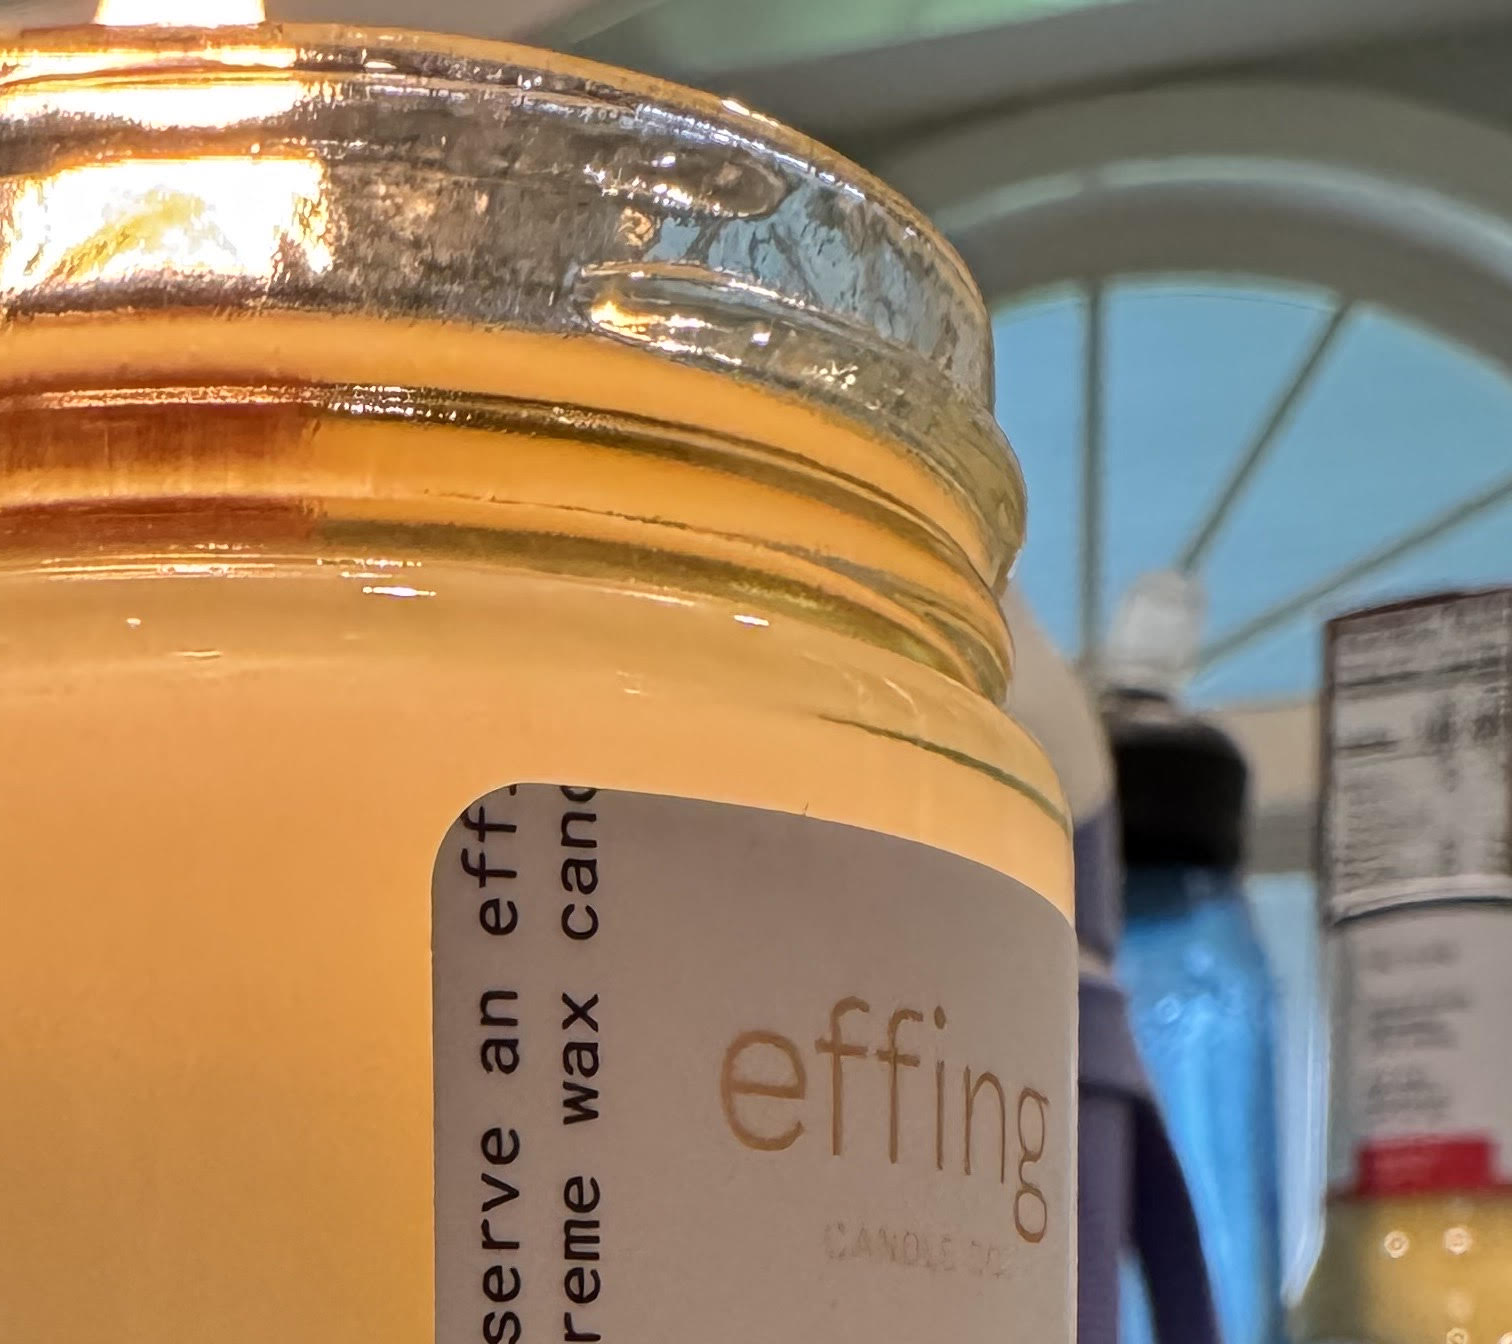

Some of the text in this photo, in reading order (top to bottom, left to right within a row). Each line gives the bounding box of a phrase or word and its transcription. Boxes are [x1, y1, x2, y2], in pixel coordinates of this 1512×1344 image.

[460, 783, 520, 937] eff
[479, 990, 522, 1076] an
[561, 991, 601, 1126] wax
[720, 995, 1050, 1245] effing
